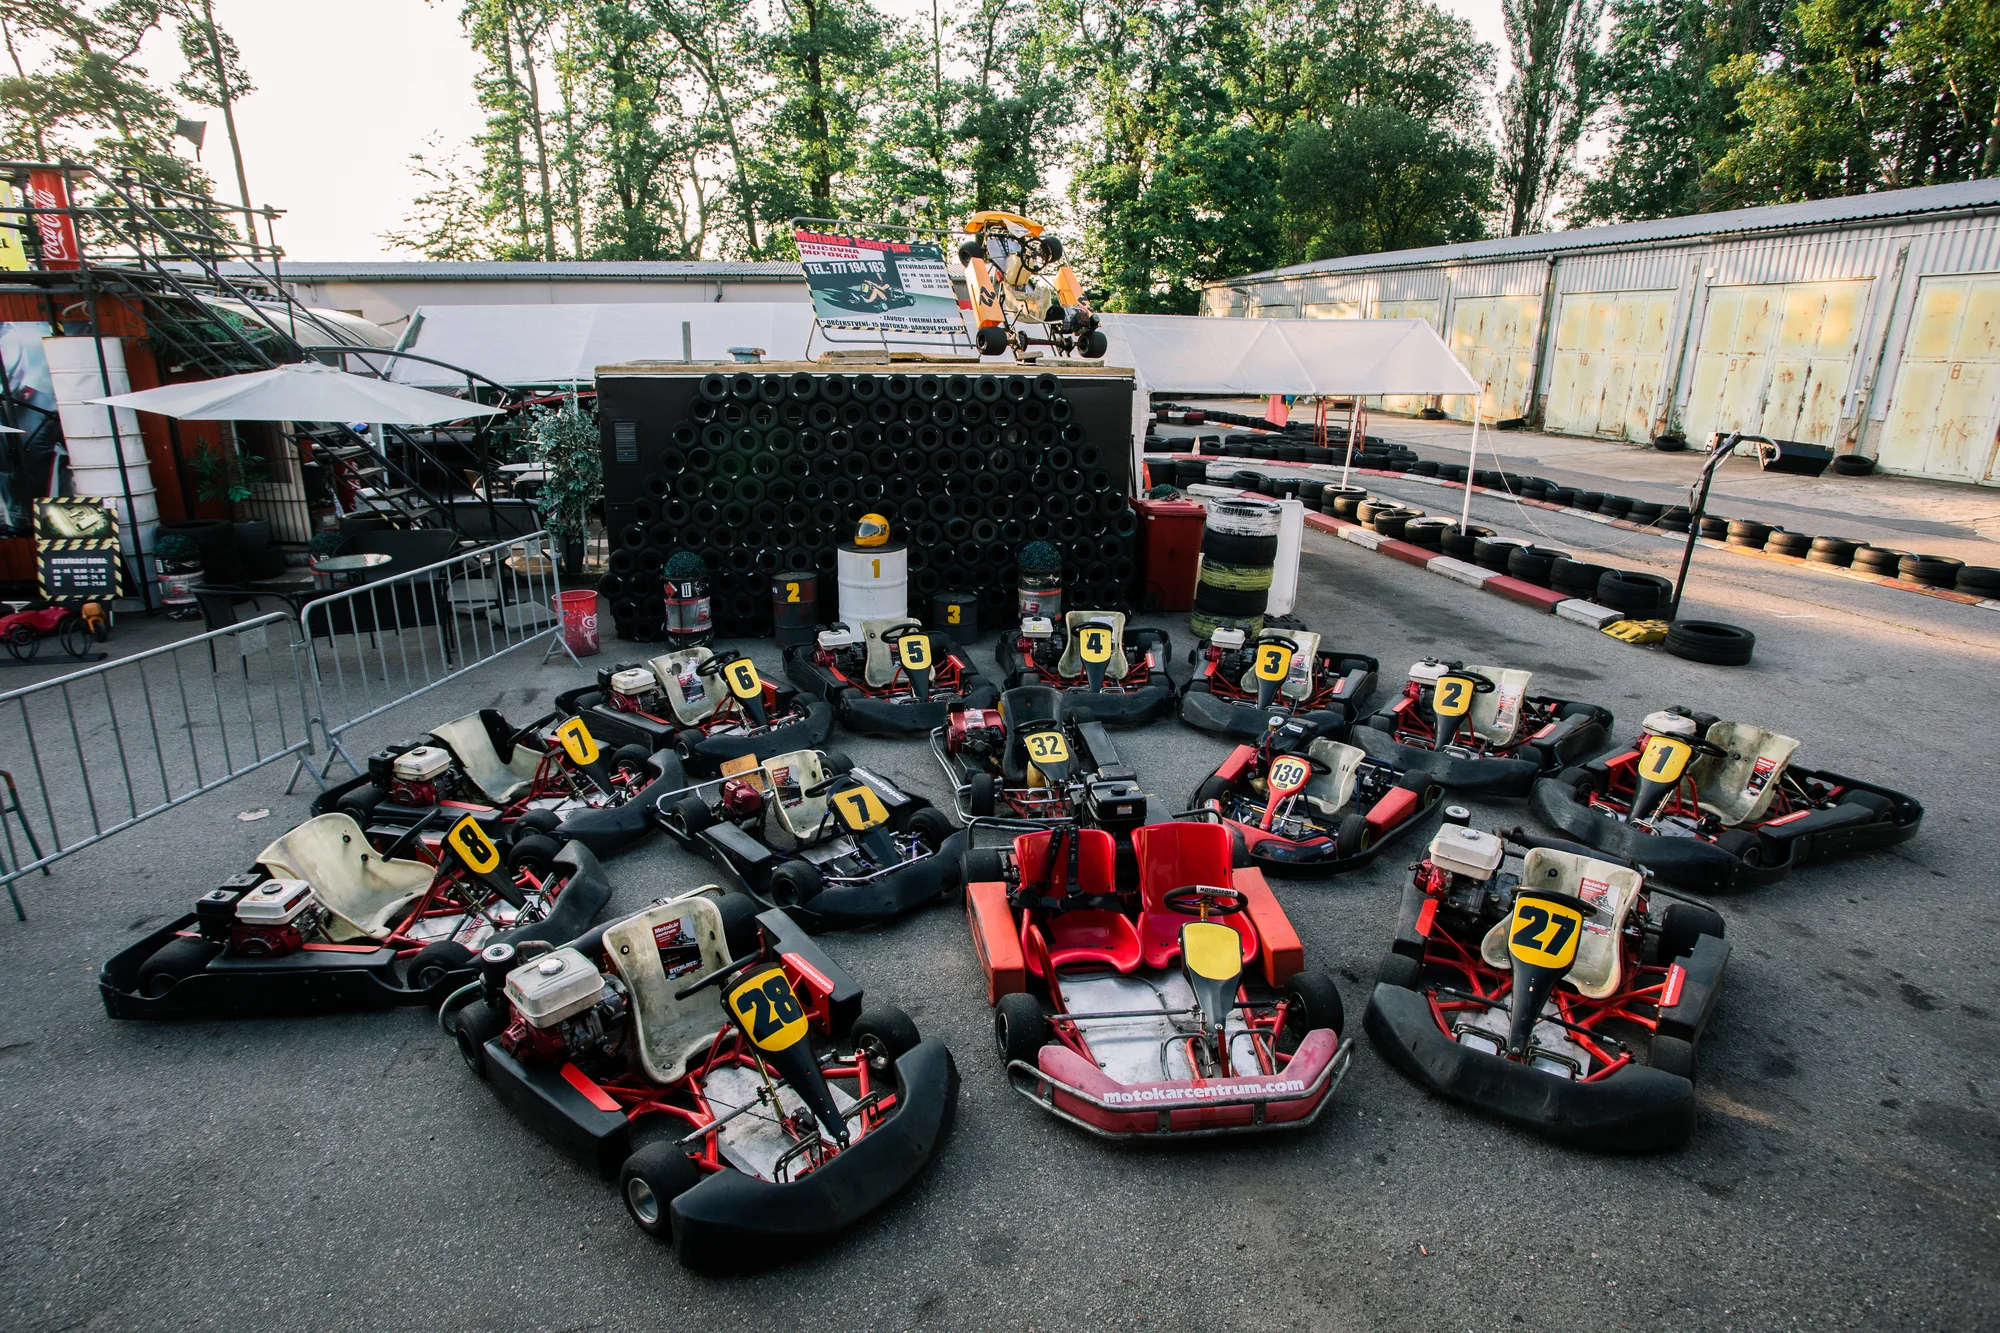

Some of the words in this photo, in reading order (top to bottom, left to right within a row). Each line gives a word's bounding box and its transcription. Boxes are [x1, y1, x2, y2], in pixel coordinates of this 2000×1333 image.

[829, 262, 848, 274] 777
[847, 261, 867, 273] 194
[867, 261, 886, 273] 163
[1950, 364, 1963, 380] 8
[871, 558, 881, 579] 1
[786, 582, 801, 603] 2
[947, 604, 961, 625] 3
[907, 640, 924, 663] 5
[1087, 632, 1103, 654] 4
[1264, 650, 1281, 674] 3
[735, 665, 755, 690] 6
[1441, 683, 1463, 708] 2
[567, 726, 589, 758] 7
[1031, 736, 1063, 757] 32
[1654, 745, 1674, 774] 1
[1272, 763, 1304, 785] 139
[847, 794, 870, 823] 7
[458, 824, 492, 865] 8
[1200, 887, 1236, 896] MOTORSPORT
[1511, 905, 1577, 956] 27
[736, 975, 804, 1043] 28
[1103, 1080, 1305, 1104] motokarcentrum.com
